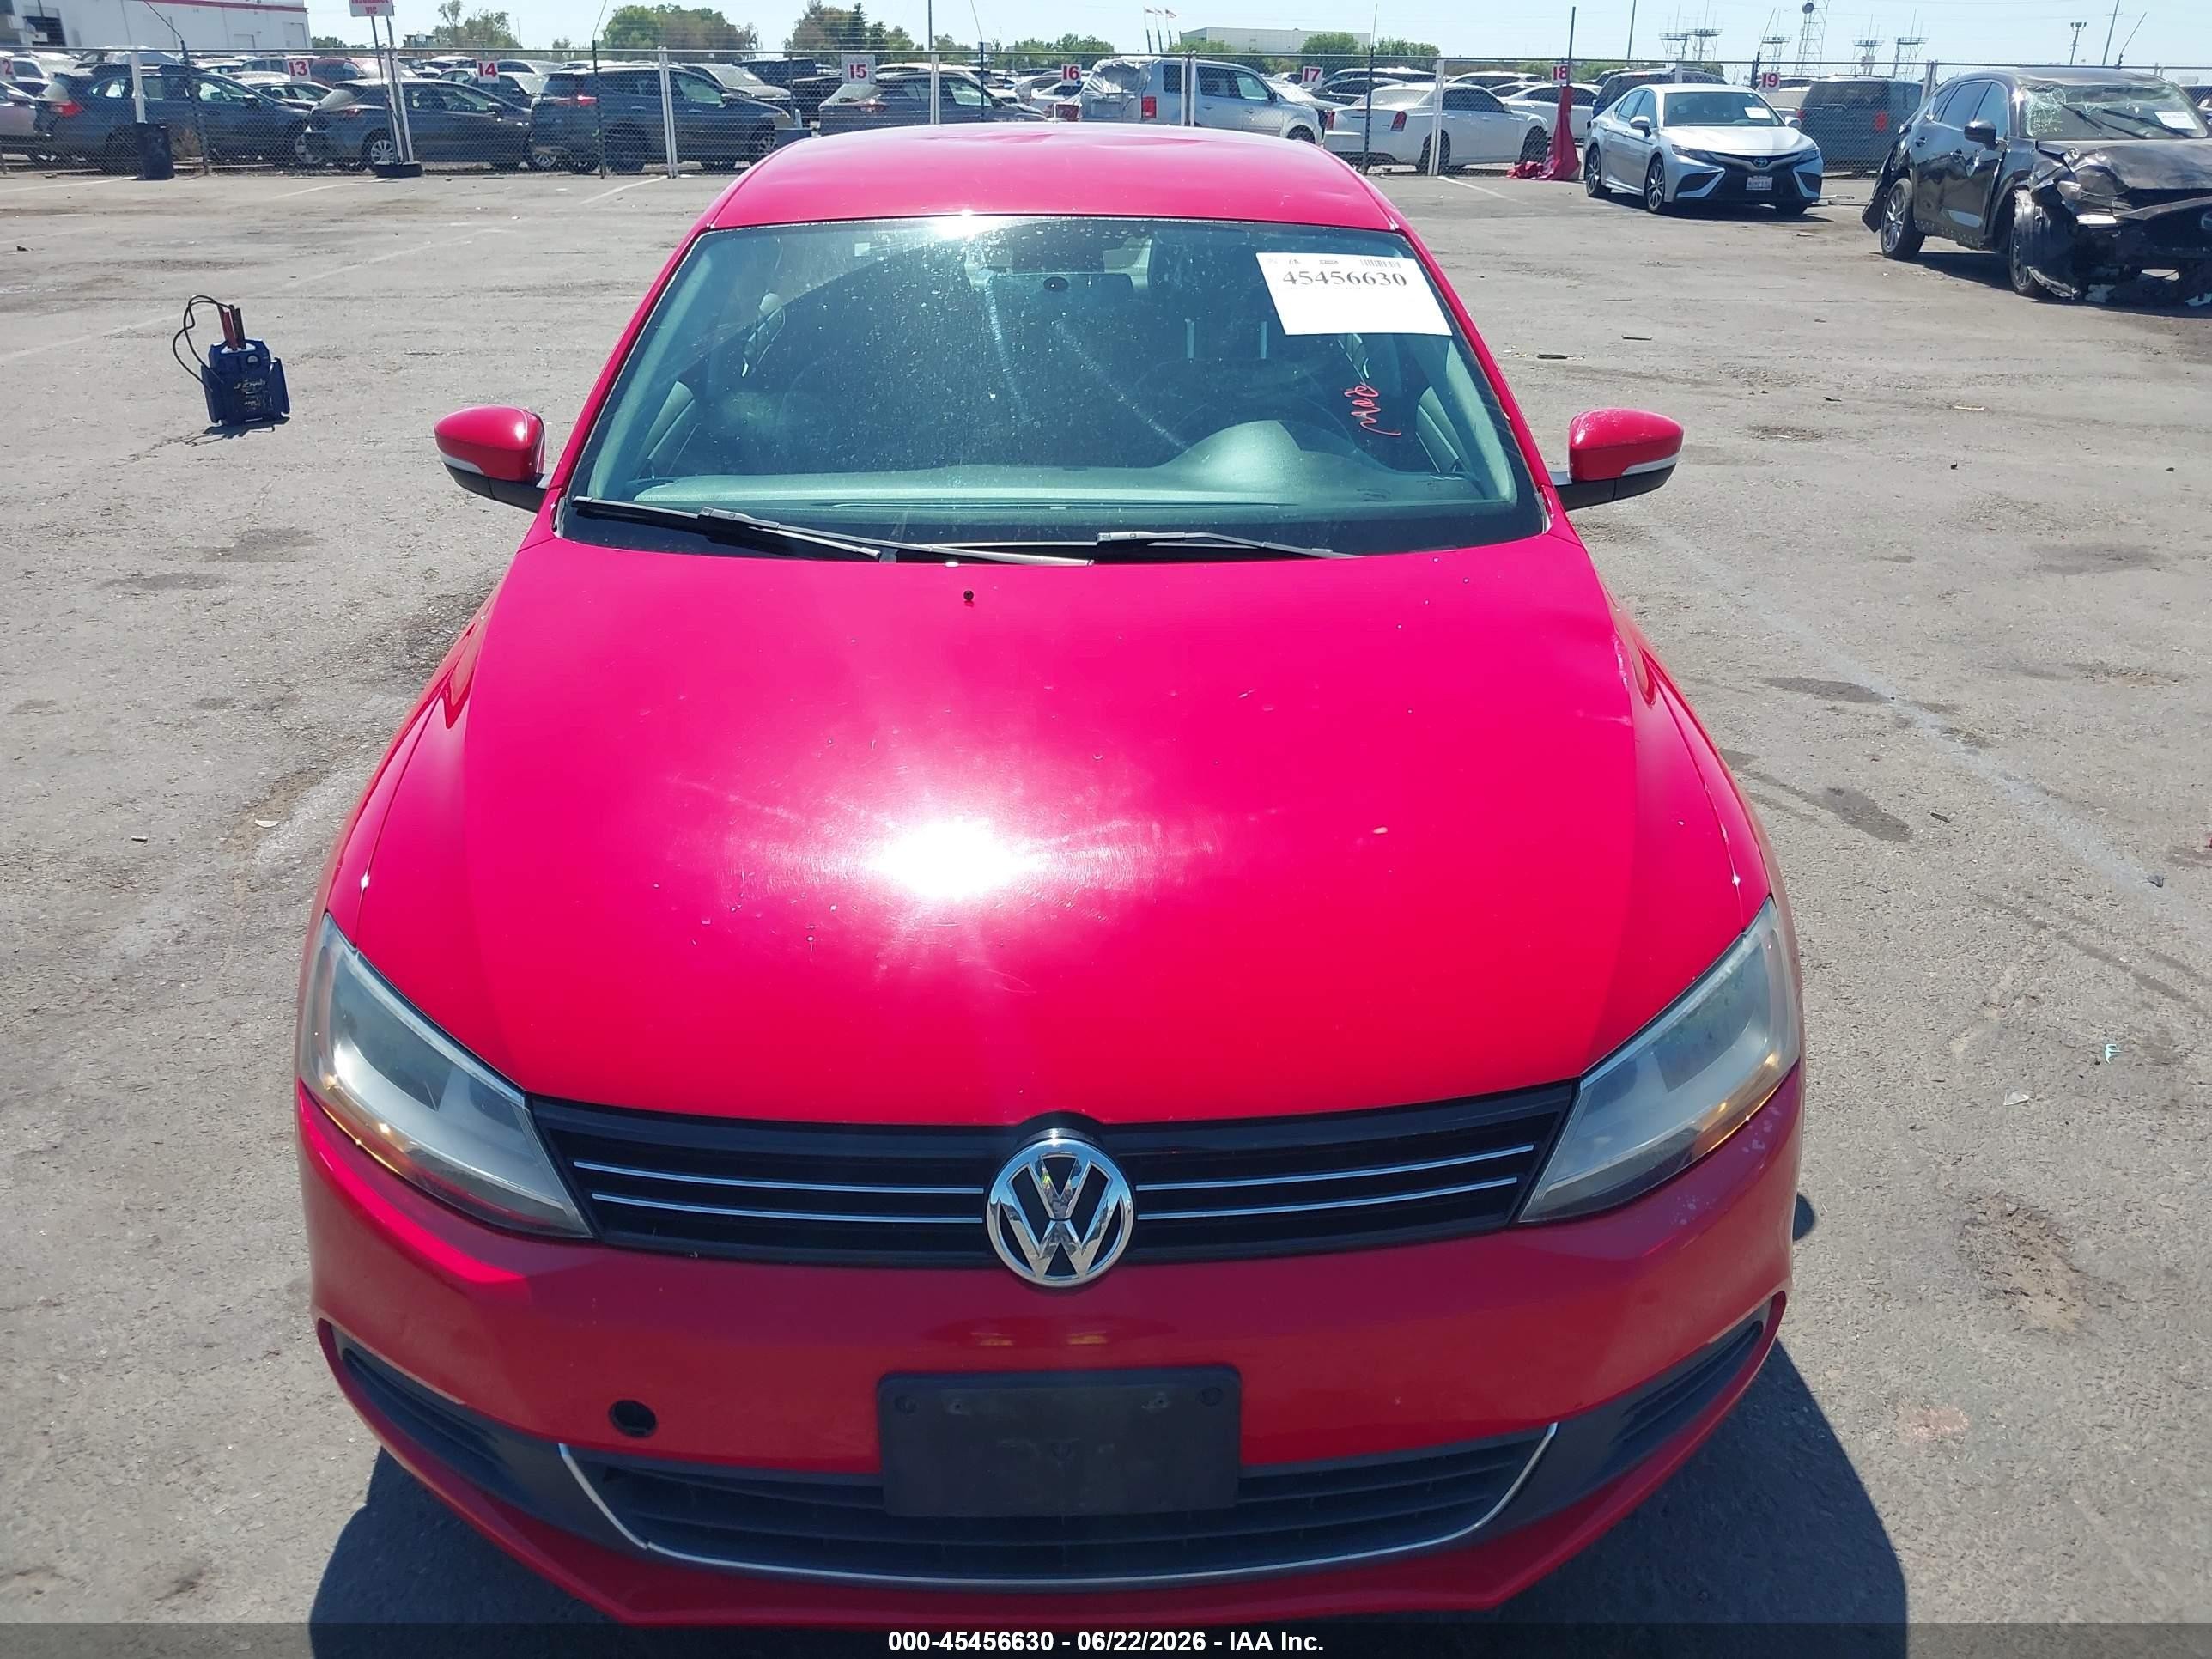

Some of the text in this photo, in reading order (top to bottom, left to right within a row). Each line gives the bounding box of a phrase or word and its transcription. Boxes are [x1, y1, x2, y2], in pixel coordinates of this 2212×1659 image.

[289, 61, 308, 76] 13
[477, 62, 497, 77] 14
[850, 64, 867, 79] 15
[1063, 65, 1079, 81] 16
[1304, 68, 1322, 83] 17
[1553, 65, 1568, 81] 18
[1763, 73, 1778, 88] 19
[1282, 270, 1408, 287] 45456630
